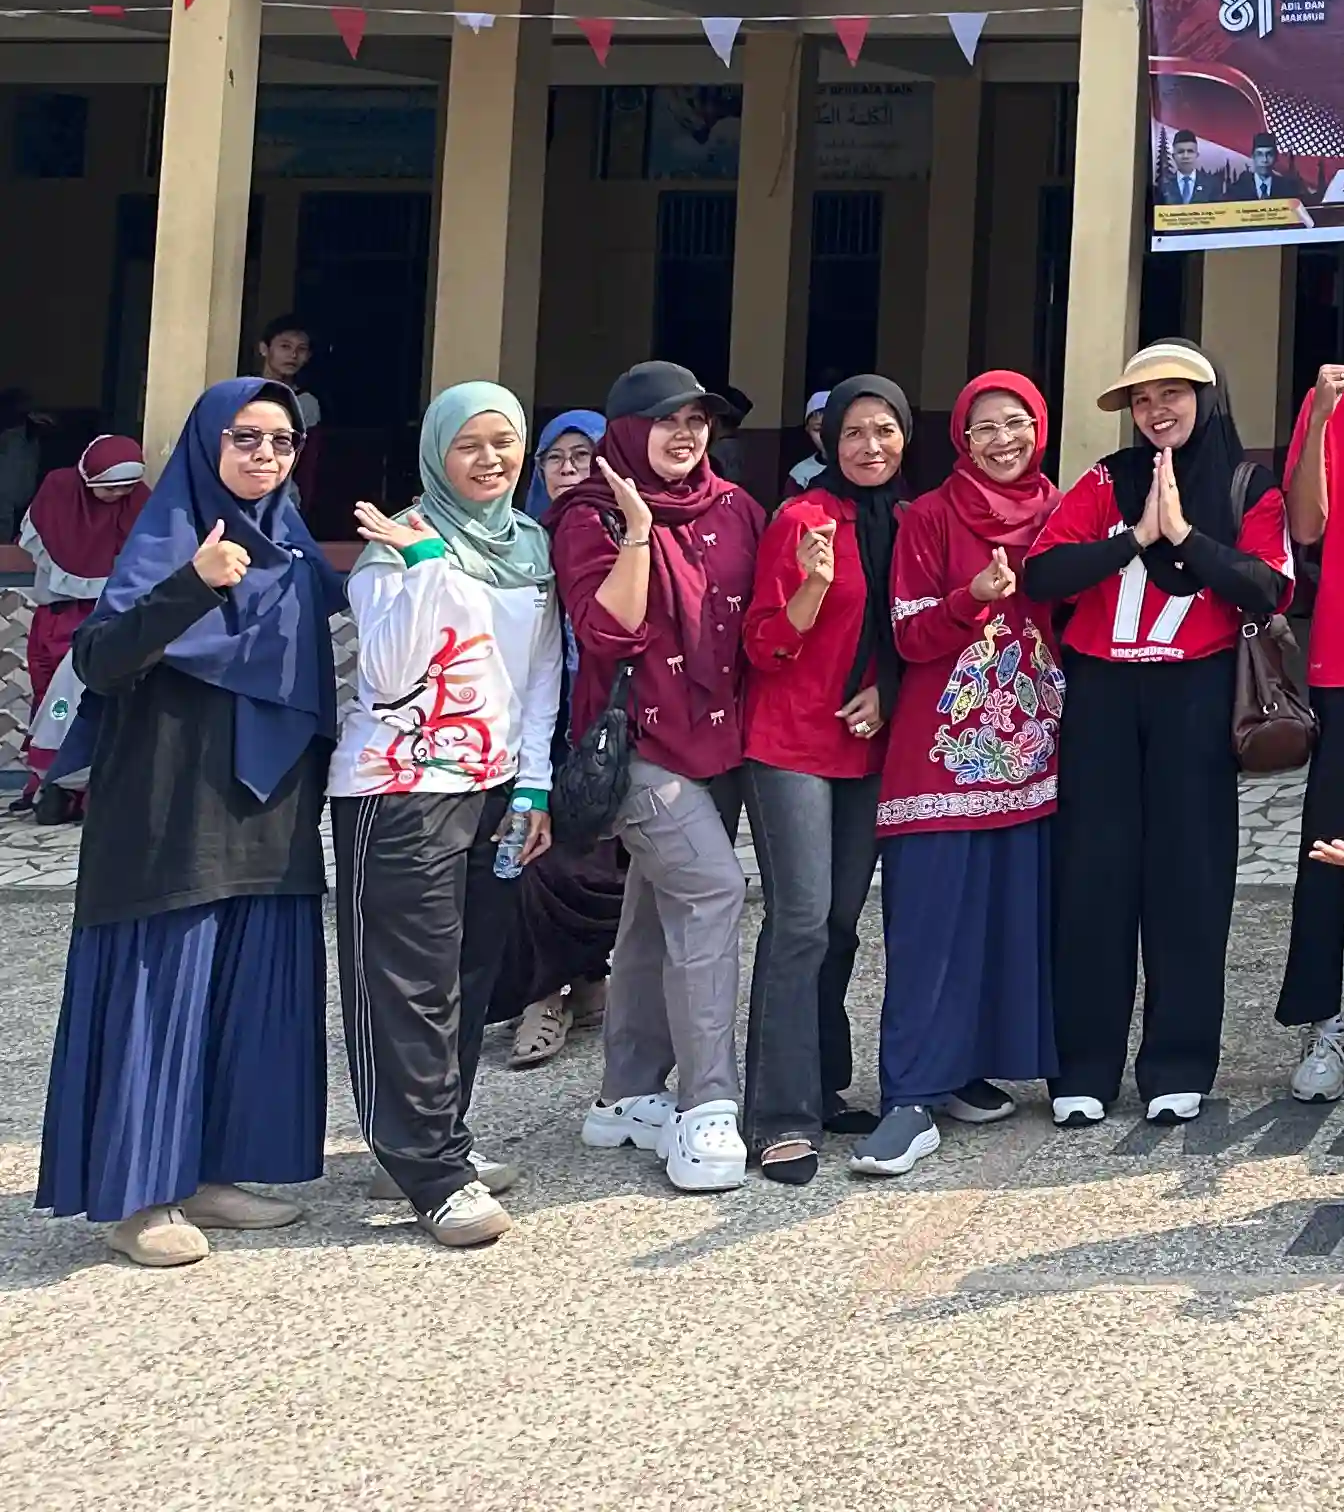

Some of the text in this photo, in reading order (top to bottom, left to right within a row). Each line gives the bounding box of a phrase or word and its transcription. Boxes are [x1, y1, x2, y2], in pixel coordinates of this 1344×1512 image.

[1281, 0, 1325, 11] ADIL DAN
[1281, 12, 1325, 23] MAKMUR
